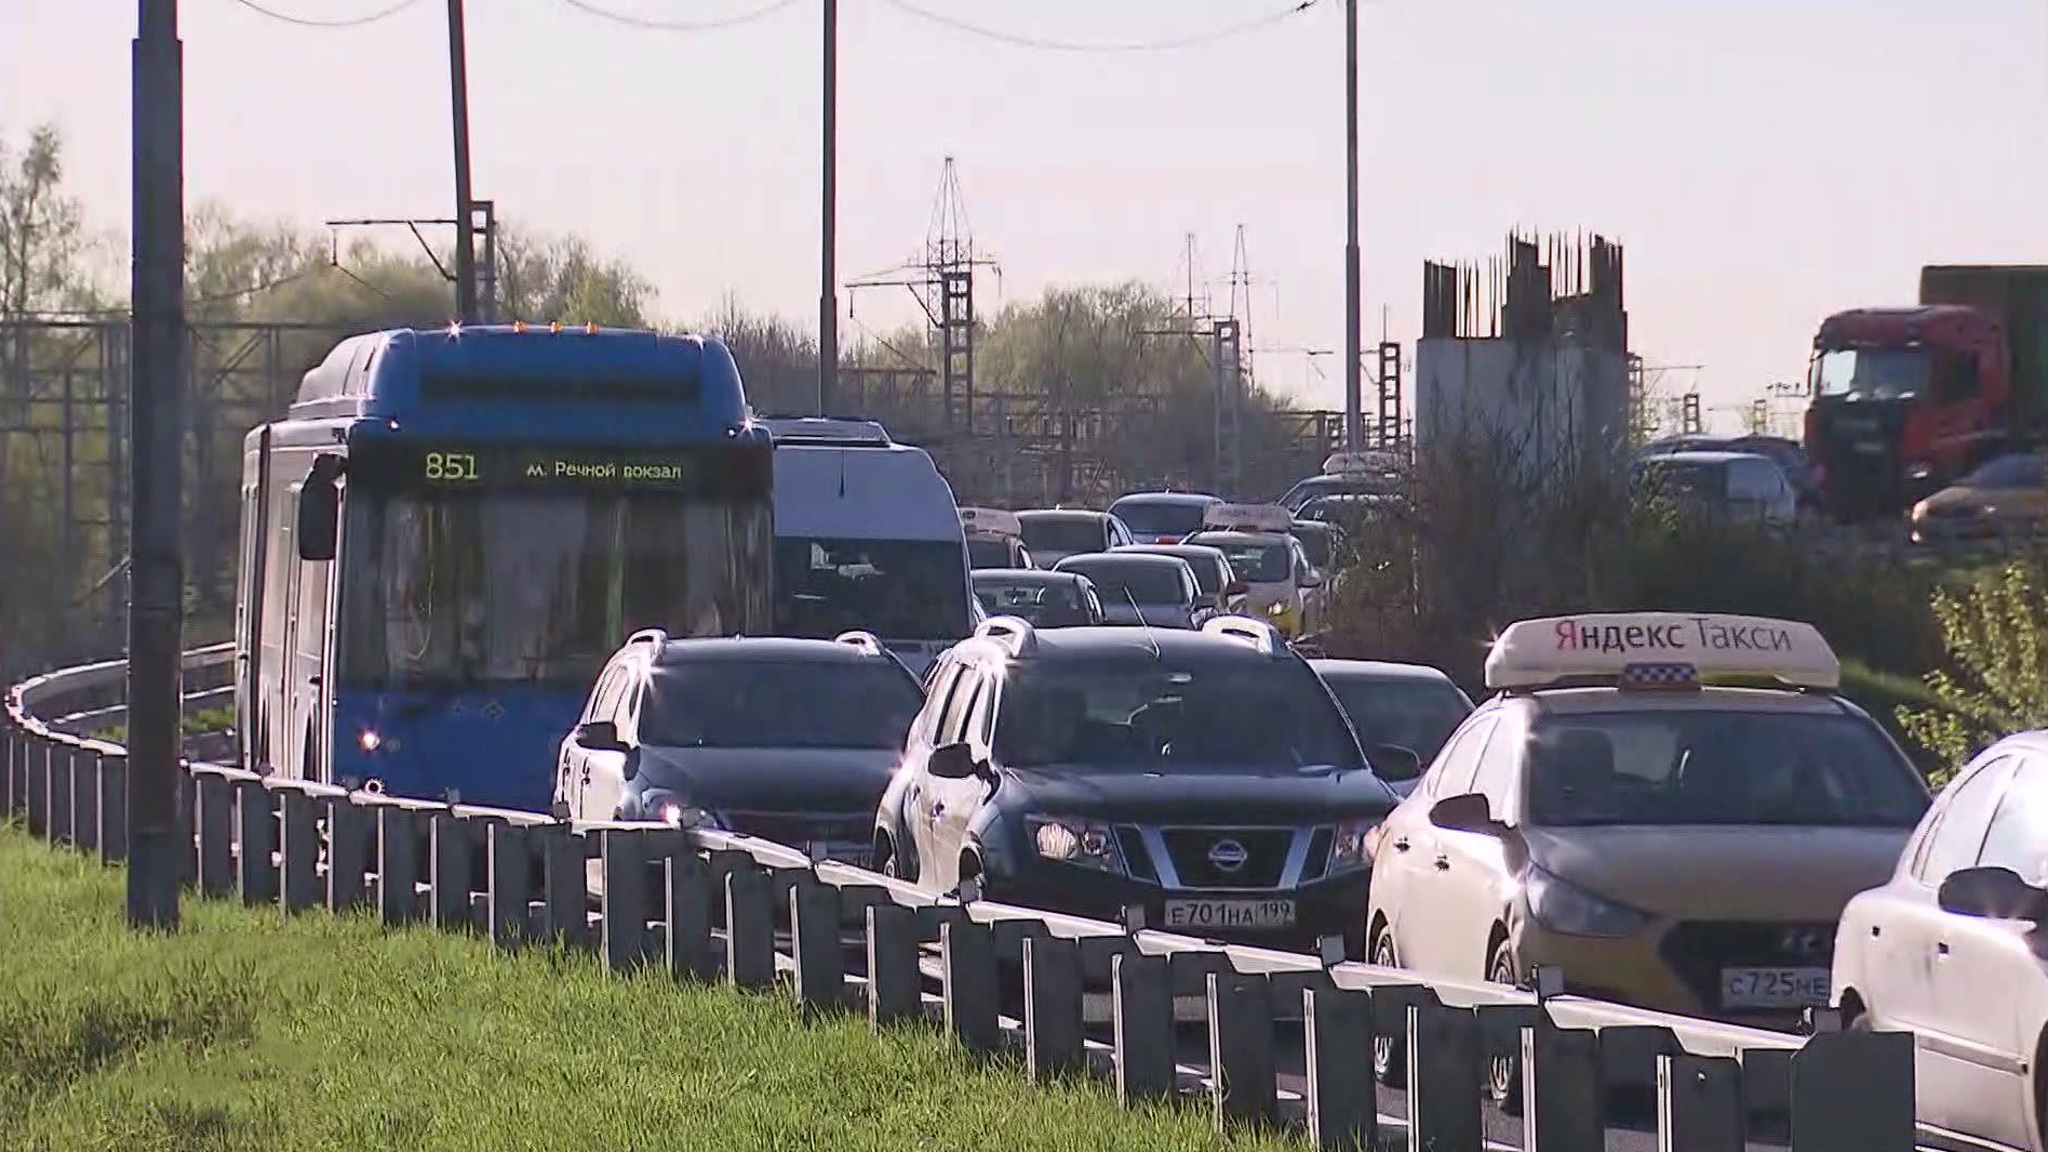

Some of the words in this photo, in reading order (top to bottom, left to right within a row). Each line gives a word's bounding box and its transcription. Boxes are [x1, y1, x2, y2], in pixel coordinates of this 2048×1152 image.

[425, 452, 479, 480] 851
[554, 461, 616, 478] Речной
[623, 465, 682, 479] вокзал
[1555, 619, 1685, 653] Яндекс
[1687, 617, 1792, 651] Такси
